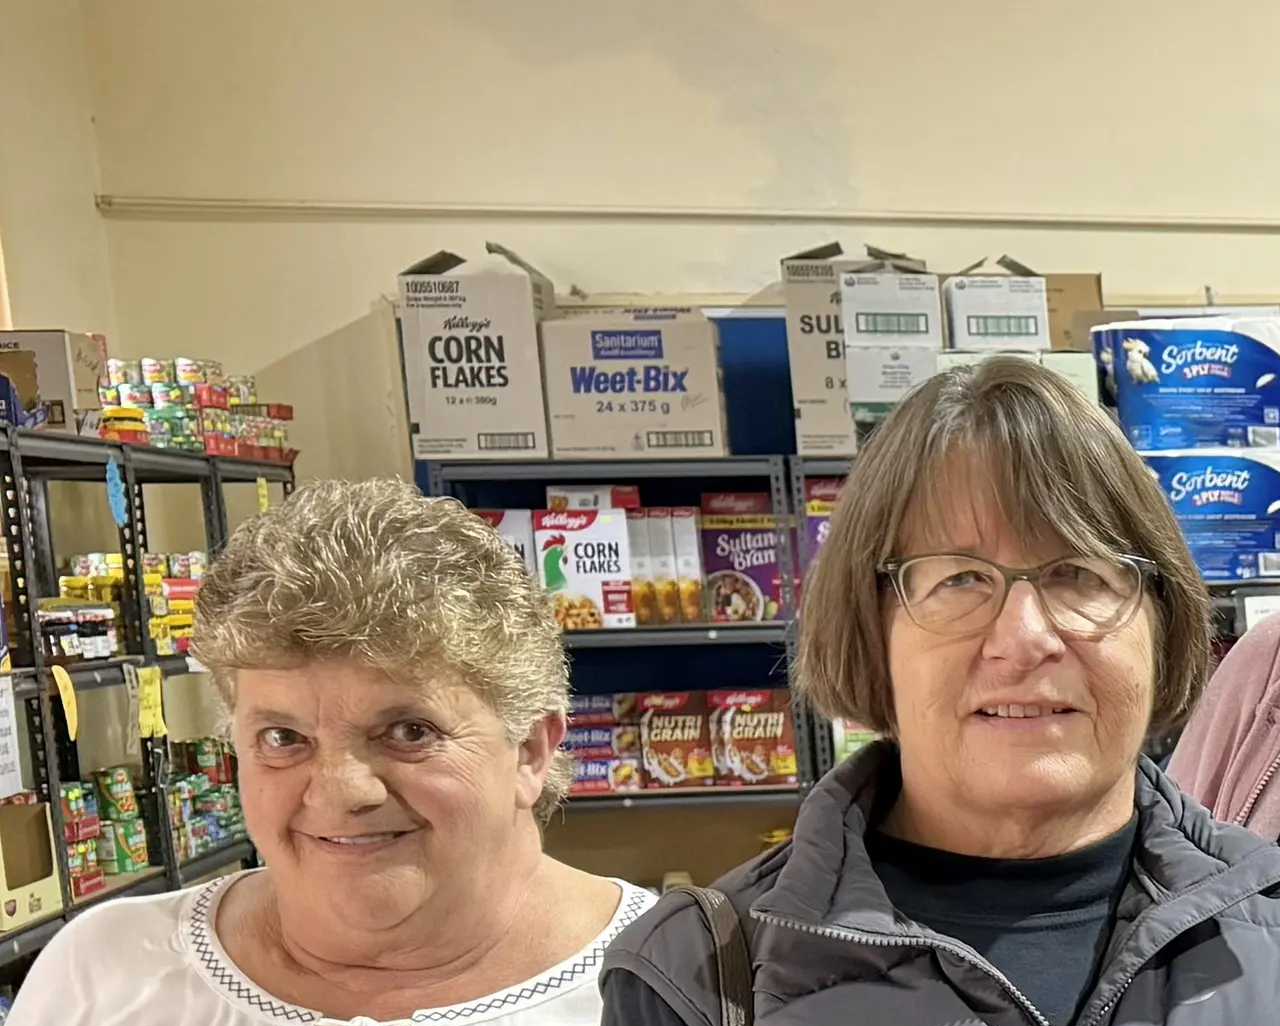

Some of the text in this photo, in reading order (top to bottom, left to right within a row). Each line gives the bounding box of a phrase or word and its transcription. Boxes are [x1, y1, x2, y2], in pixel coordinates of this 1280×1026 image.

[443, 316, 491, 332] Kellogg's
[800, 315, 844, 334] SUL
[428, 335, 505, 364] CORN
[595, 334, 659, 348] Sanitarium
[1161, 341, 1239, 374] Sorbent
[430, 365, 509, 388] FLAKES
[570, 366, 689, 394] Weet-Bix
[597, 401, 614, 413] 24
[618, 403, 627, 412] x
[631, 400, 656, 413] 375
[661, 402, 671, 415] g
[1170, 466, 1249, 501] Sorbent
[574, 542, 620, 560] CORN
[730, 548, 777, 571] Bran
[576, 559, 622, 574] FLAKES
[650, 715, 702, 729] NUTRI
[649, 727, 701, 741] GRAIN
